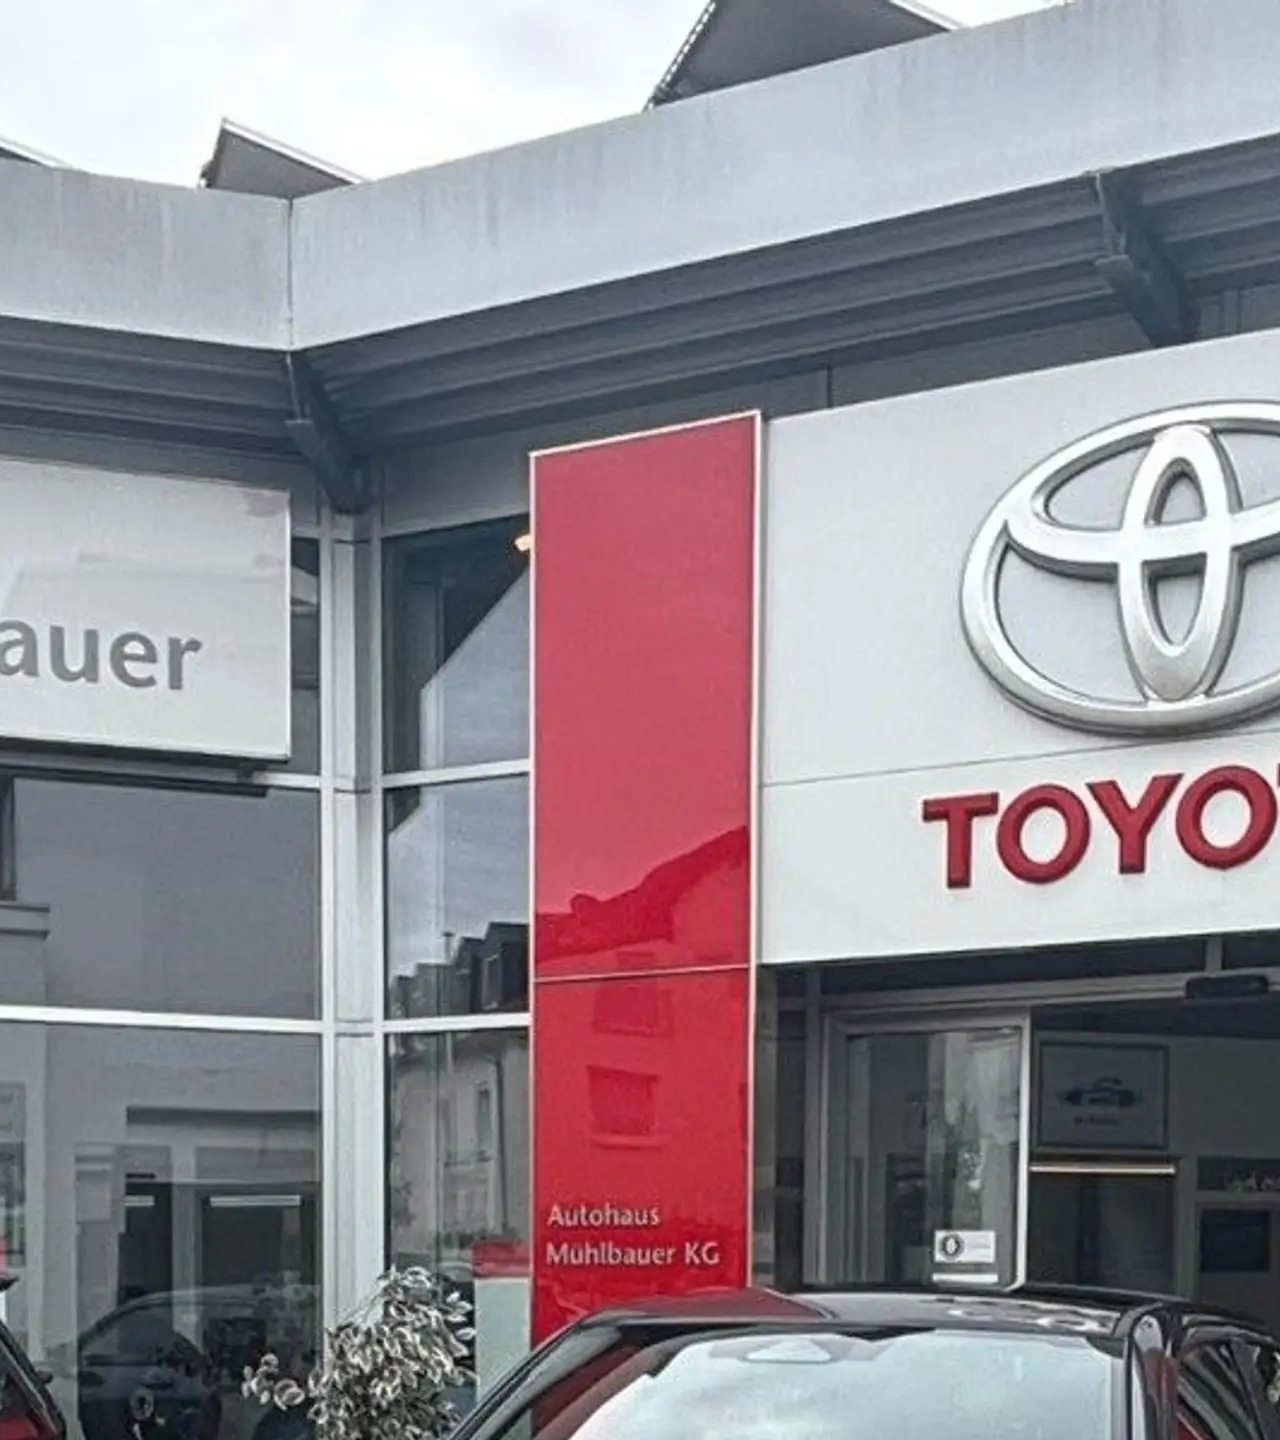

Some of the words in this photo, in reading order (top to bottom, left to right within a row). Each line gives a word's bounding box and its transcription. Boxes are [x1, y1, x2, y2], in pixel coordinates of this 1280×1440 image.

[547, 1203, 661, 1226] Autohaus
[546, 1241, 676, 1265] Mühlbauer
[684, 1241, 720, 1265] KG
